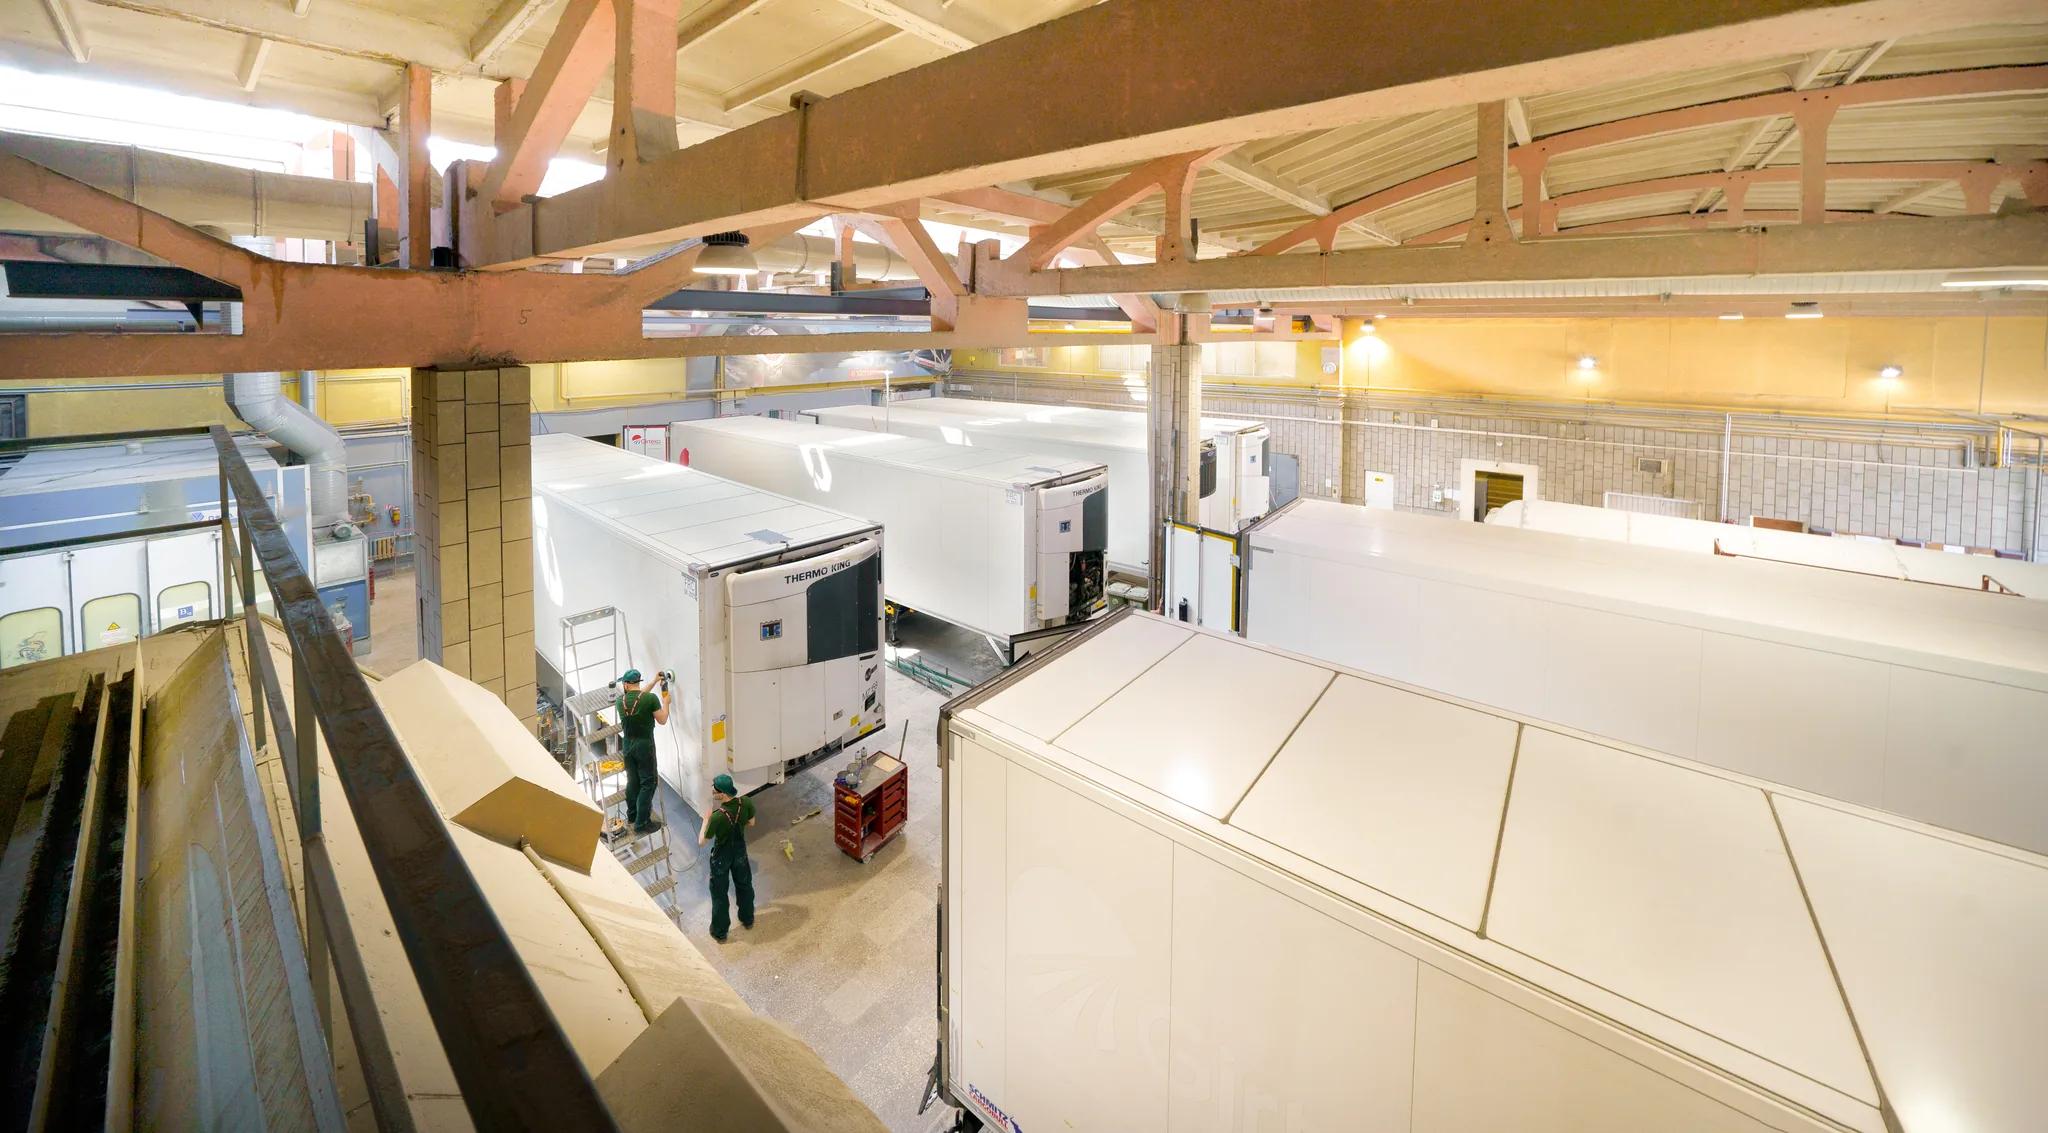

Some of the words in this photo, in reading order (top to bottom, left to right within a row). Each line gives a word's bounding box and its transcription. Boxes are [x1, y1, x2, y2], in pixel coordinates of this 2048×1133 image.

[1072, 486, 1094, 497] THERMO
[784, 567, 828, 584] THERMO
[831, 559, 851, 573] KING
[968, 1091, 1008, 1130] CARGOBULL
[969, 1083, 1008, 1123] SCHMITZ
